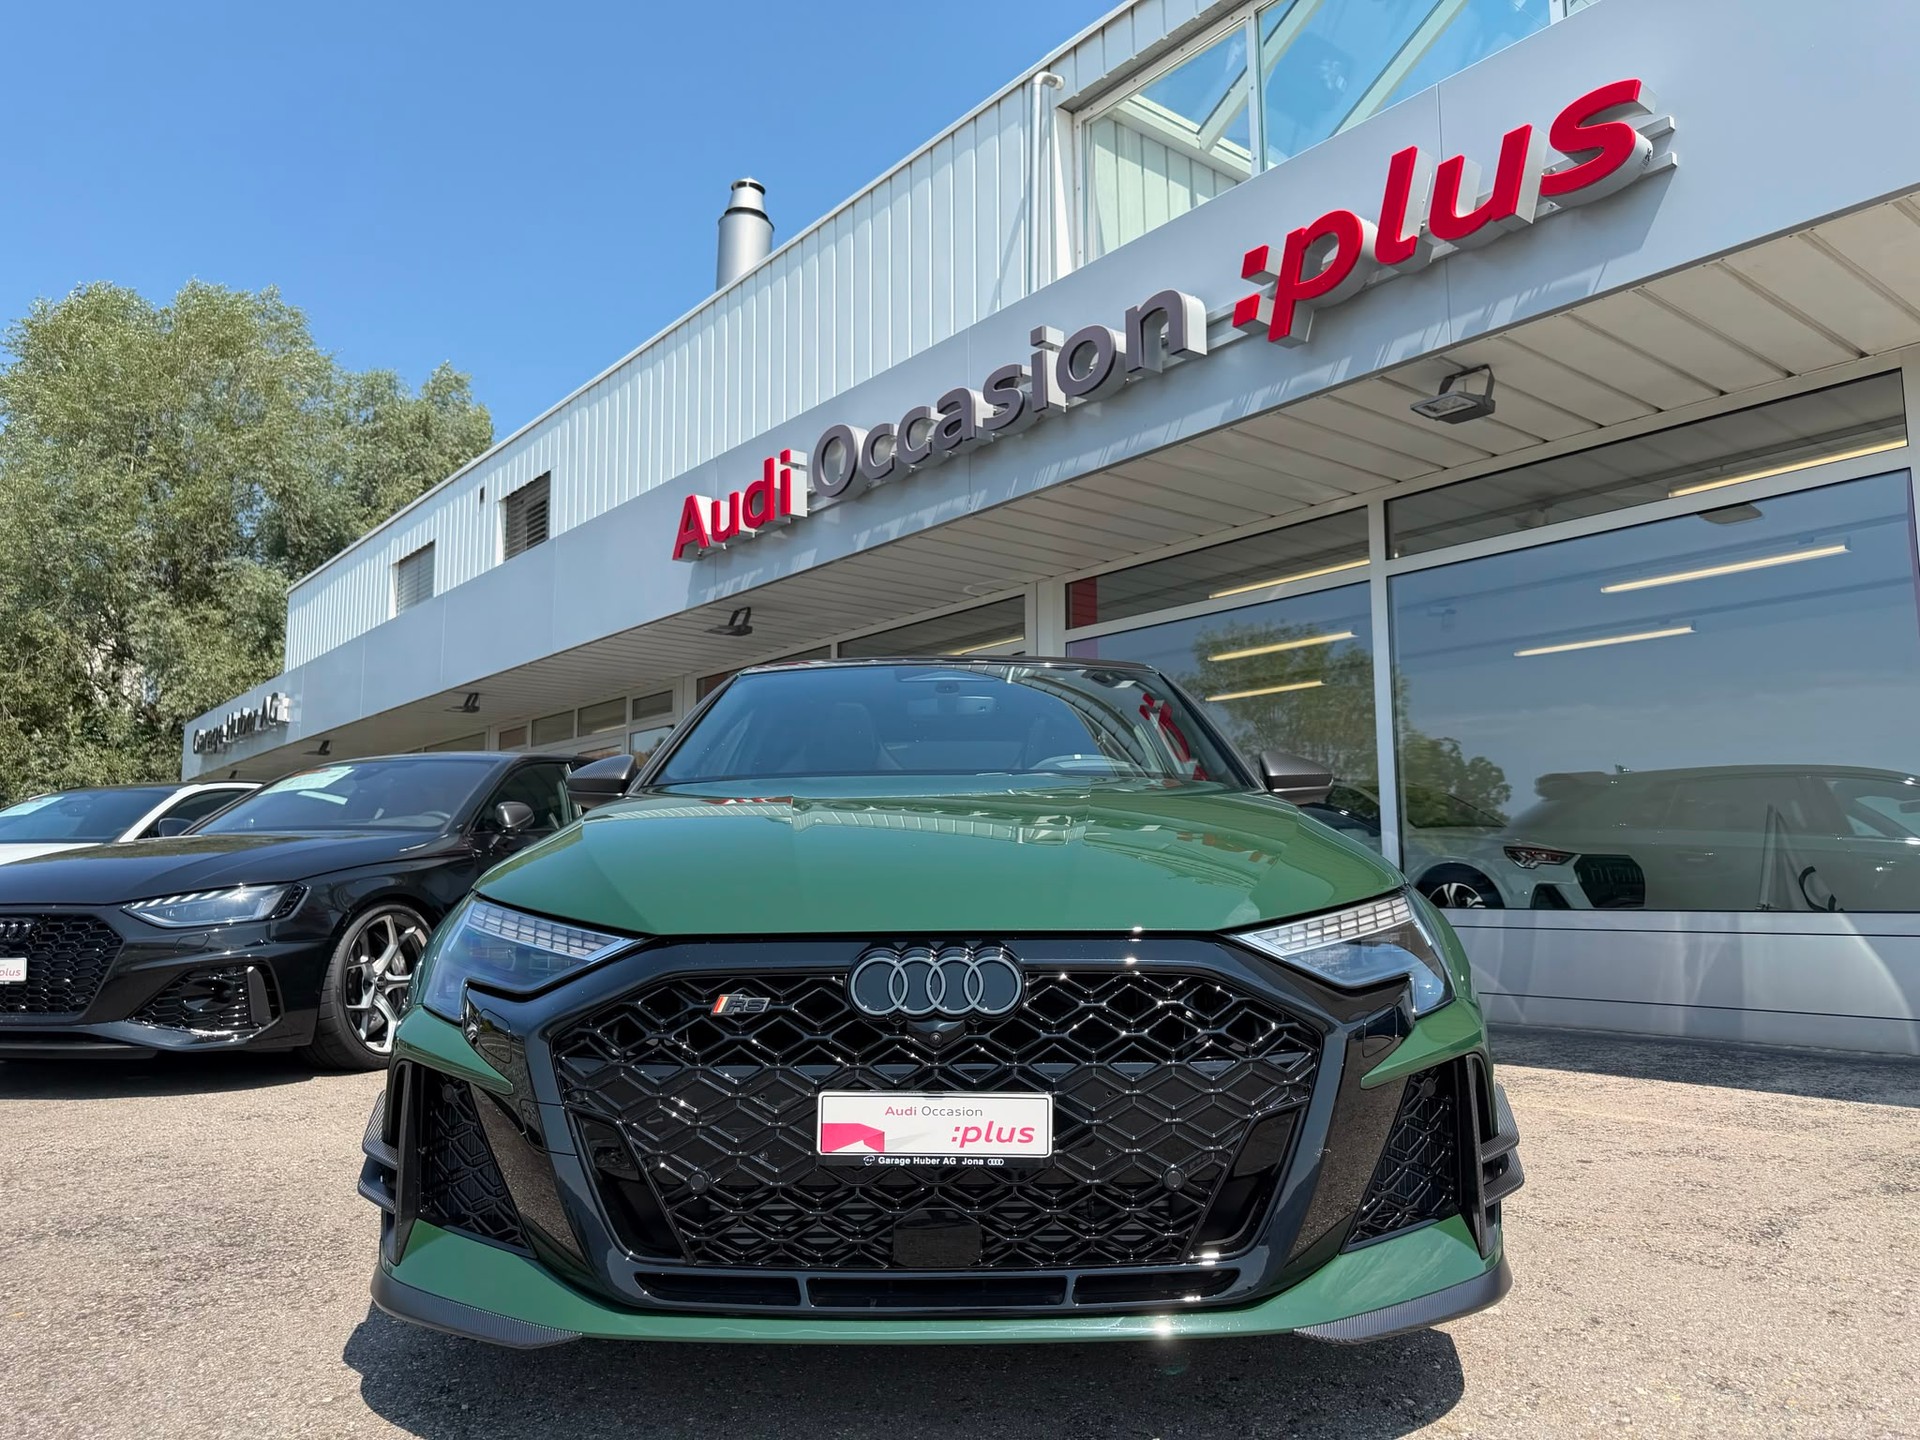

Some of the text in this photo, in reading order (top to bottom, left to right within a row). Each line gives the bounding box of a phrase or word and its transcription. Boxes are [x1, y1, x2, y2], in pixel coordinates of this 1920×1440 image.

[672, 78, 1648, 561] Audi Occasion :plus
[259, 692, 281, 729] AG
[724, 995, 768, 1014] RS
[884, 1105, 983, 1117] Audi Occasion
[951, 1120, 1036, 1149] :plus
[878, 1156, 911, 1167] Garage
[913, 1156, 939, 1166] Huber
[943, 1157, 957, 1166] AG
[962, 1157, 984, 1167] Jona
